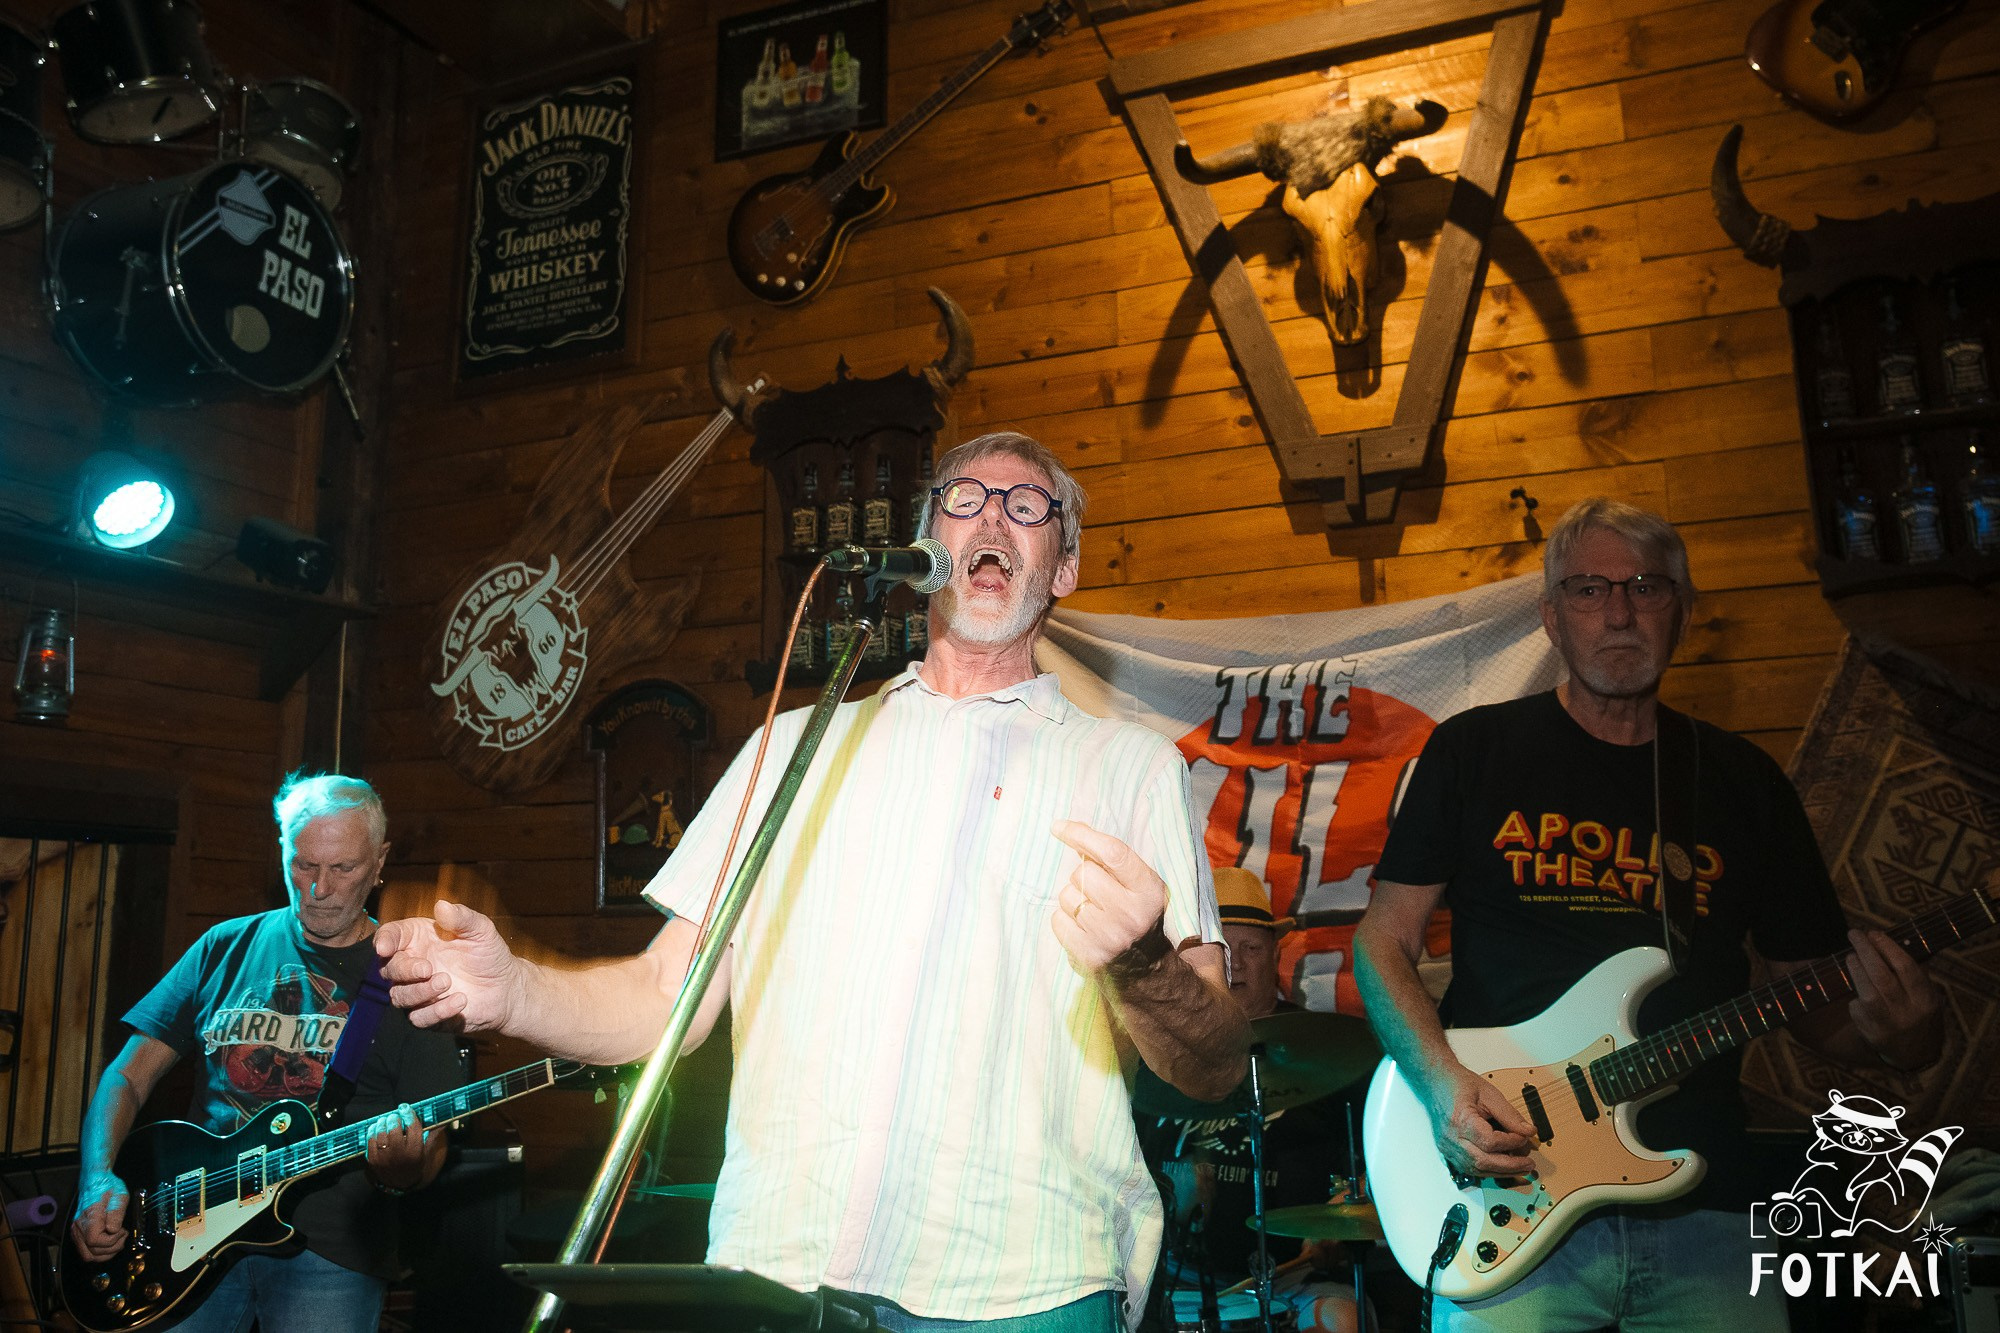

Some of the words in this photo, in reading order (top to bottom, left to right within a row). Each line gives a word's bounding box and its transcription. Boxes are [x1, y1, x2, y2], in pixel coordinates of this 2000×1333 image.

[482, 116, 539, 176] JACK
[278, 203, 312, 260] EL
[496, 218, 602, 260] Tennessee
[257, 250, 325, 319] PASO
[489, 250, 606, 295] WHISKEY
[448, 617, 471, 653] EL
[466, 570, 523, 616] PASO
[538, 632, 557, 655] 66
[489, 682, 507, 705] 18
[555, 666, 579, 705] BAR
[1206, 656, 1359, 746] THE
[213, 1012, 282, 1044] HARD
[290, 1018, 340, 1050] ROC
